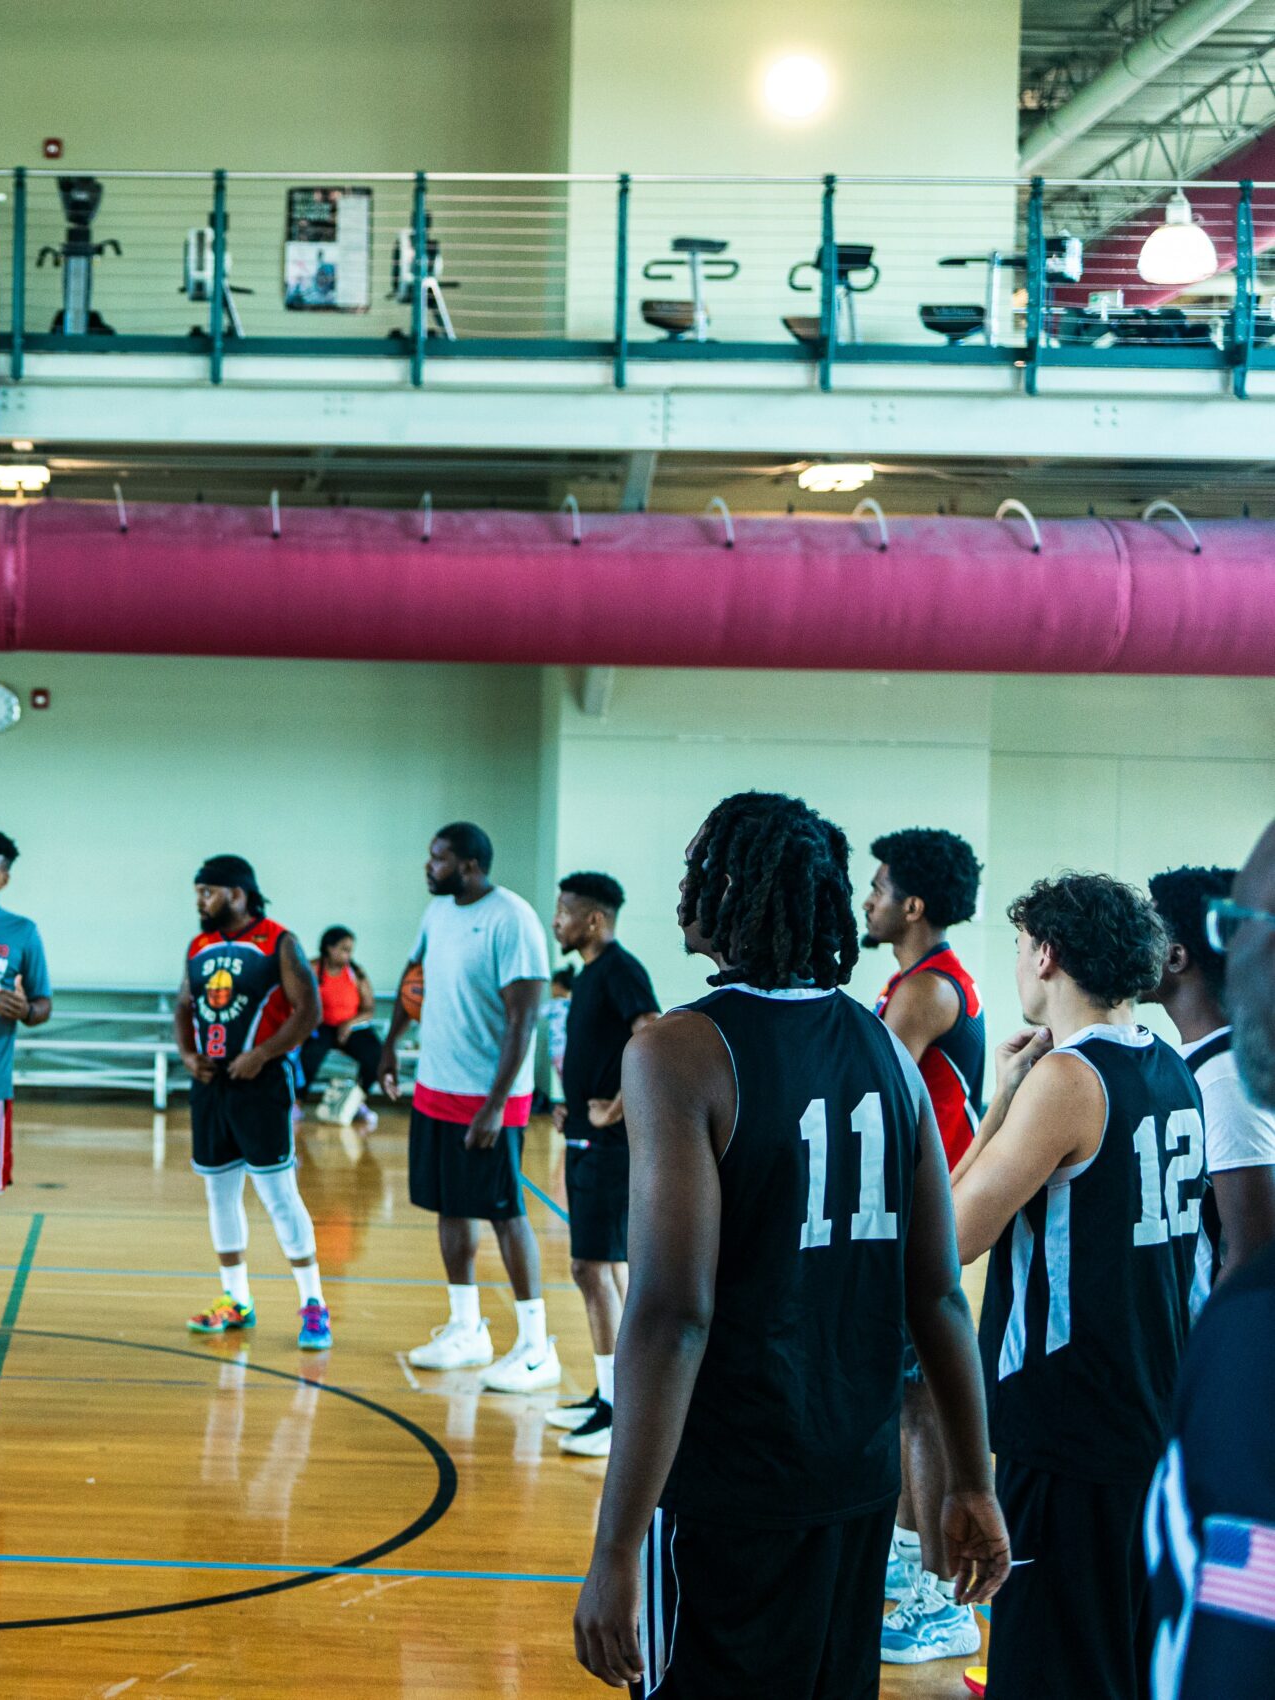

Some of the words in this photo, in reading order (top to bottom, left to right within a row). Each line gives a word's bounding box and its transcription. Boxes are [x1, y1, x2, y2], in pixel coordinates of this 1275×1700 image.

[202, 959, 215, 976] 9
[231, 958, 243, 975] 5
[207, 1024, 226, 1057] 2
[799, 1092, 897, 1250] 11
[1133, 1108, 1205, 1247] 12
